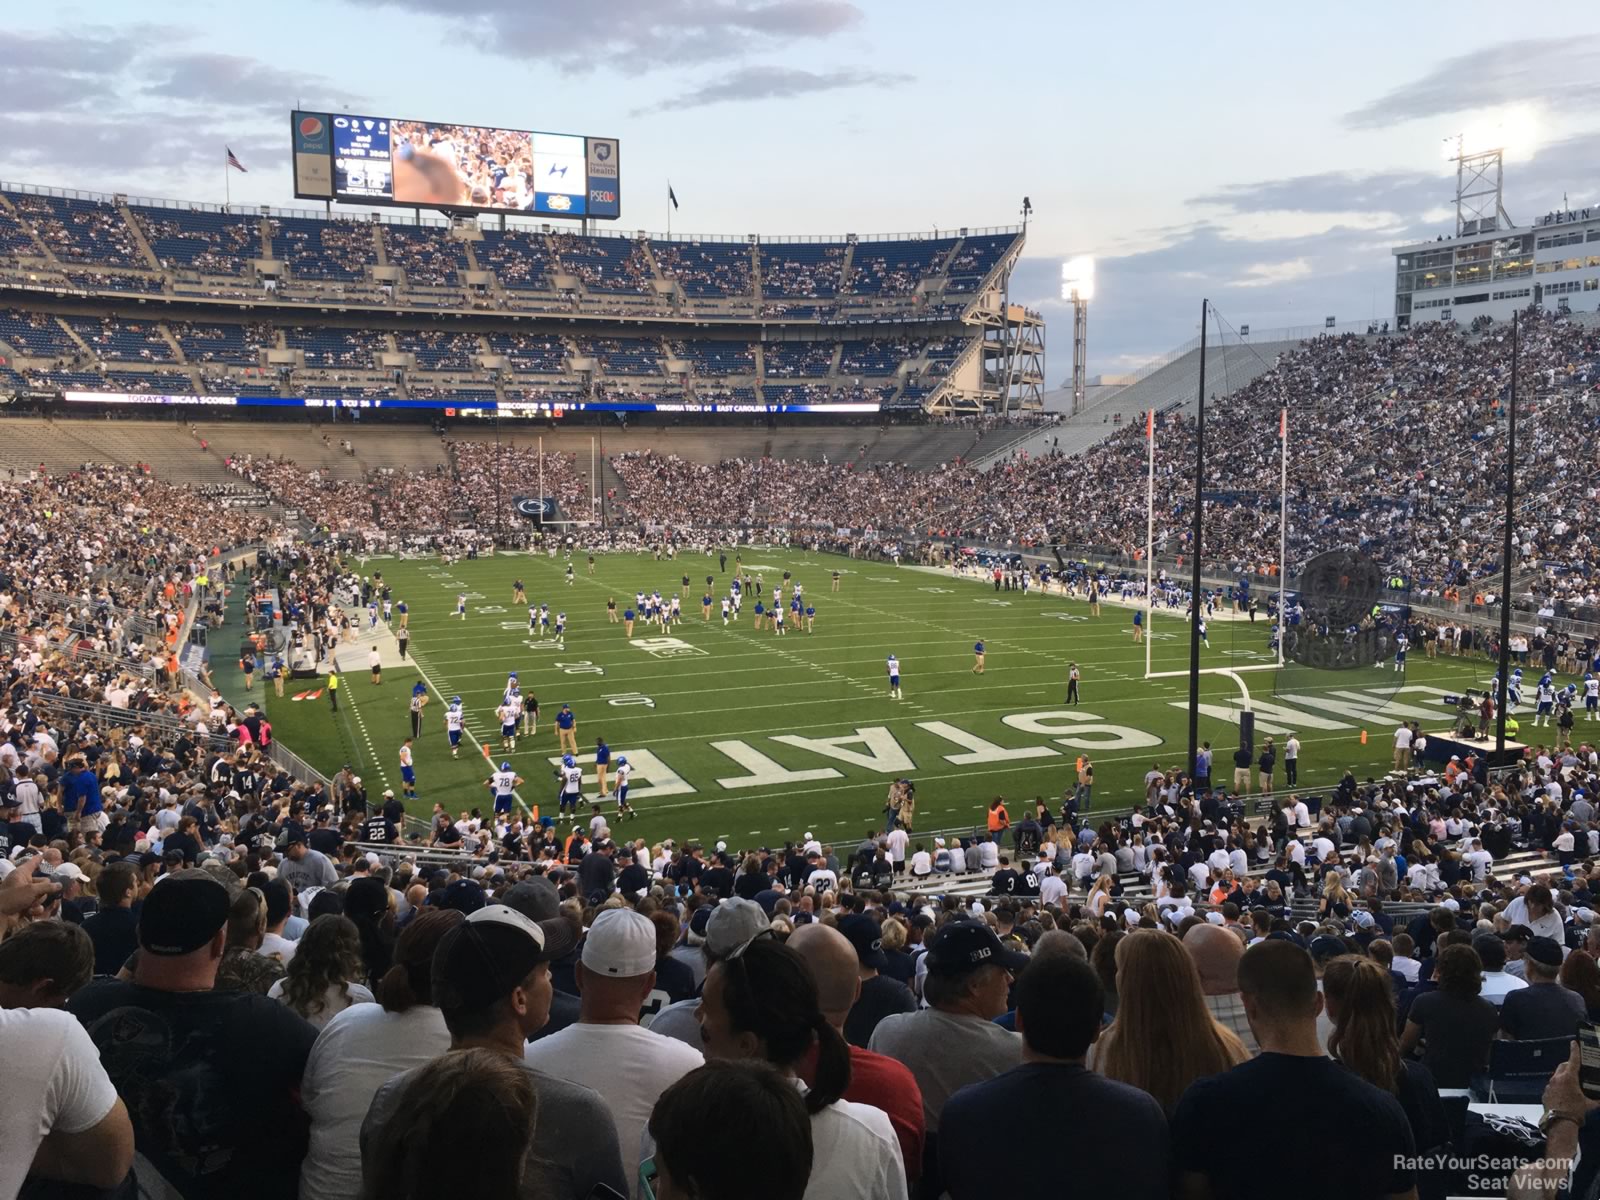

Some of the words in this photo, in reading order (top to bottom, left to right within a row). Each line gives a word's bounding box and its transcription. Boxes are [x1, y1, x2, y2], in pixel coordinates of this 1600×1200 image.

[590, 167, 616, 175] Health
[1544, 208, 1590, 226] PENN
[171, 396, 199, 404] NCAA
[200, 396, 237, 404] SCORES
[554, 661, 603, 674] 20
[600, 692, 654, 706] 10
[450, 716, 459, 724] 72
[546, 710, 1165, 799] STATE
[242, 776, 252, 790] 14
[499, 777, 510, 787] 78
[569, 773, 580, 783] 65
[370, 828, 385, 840] 22
[1484, 861, 1492, 874] 5
[816, 878, 831, 893] 22
[1007, 877, 1014, 892] 3
[1026, 873, 1038, 888] 81
